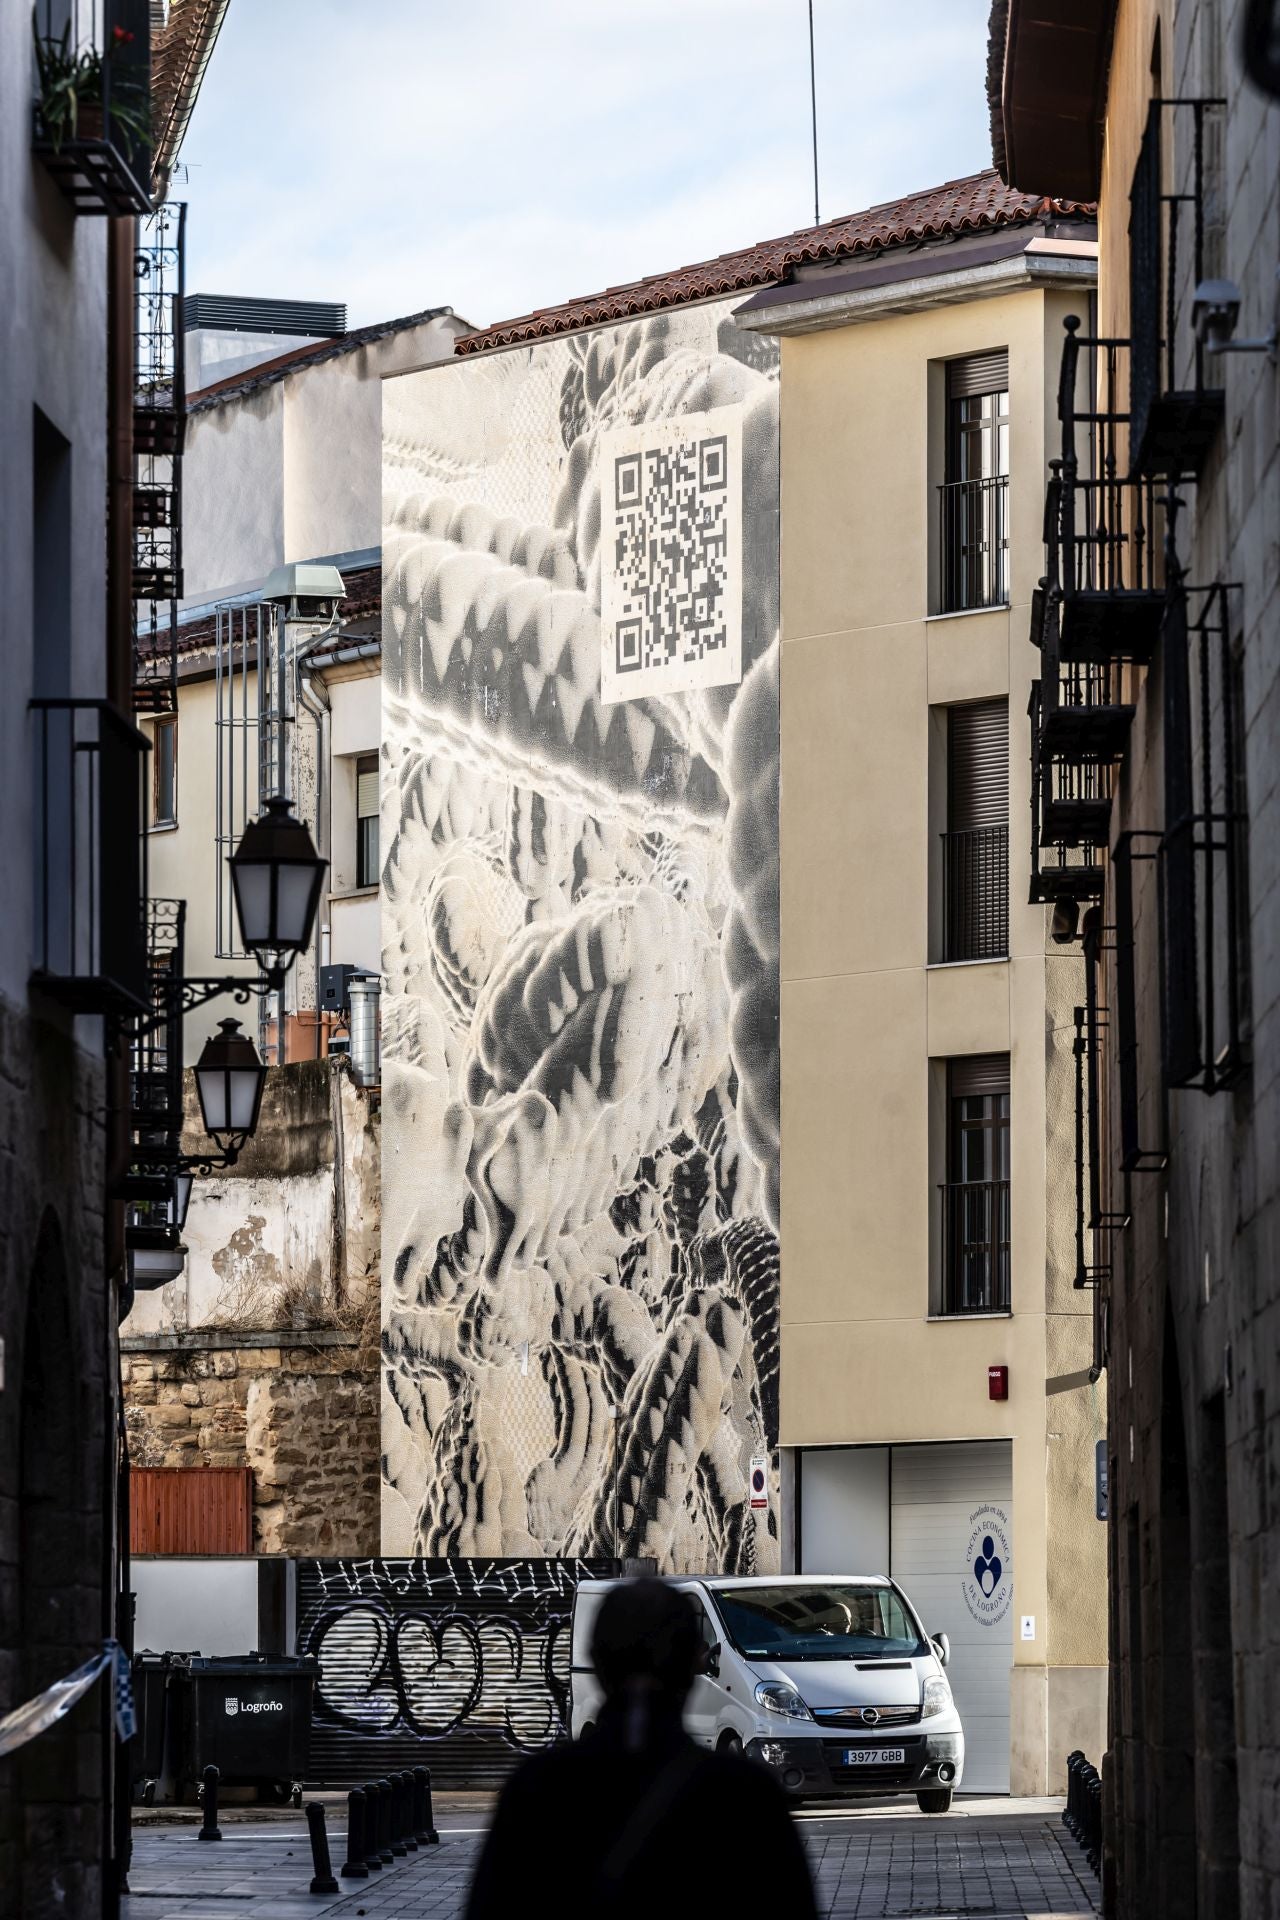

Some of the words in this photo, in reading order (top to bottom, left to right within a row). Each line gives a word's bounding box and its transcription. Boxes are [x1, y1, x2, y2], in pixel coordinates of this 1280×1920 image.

[966, 1525, 982, 1562] COCINA
[982, 1521, 1010, 1563] ECONÓMICA
[969, 1584, 977, 1600] DE
[241, 1701, 283, 1713] Logroño
[851, 1751, 878, 1762] 3977
[881, 1750, 902, 1761] GBB
